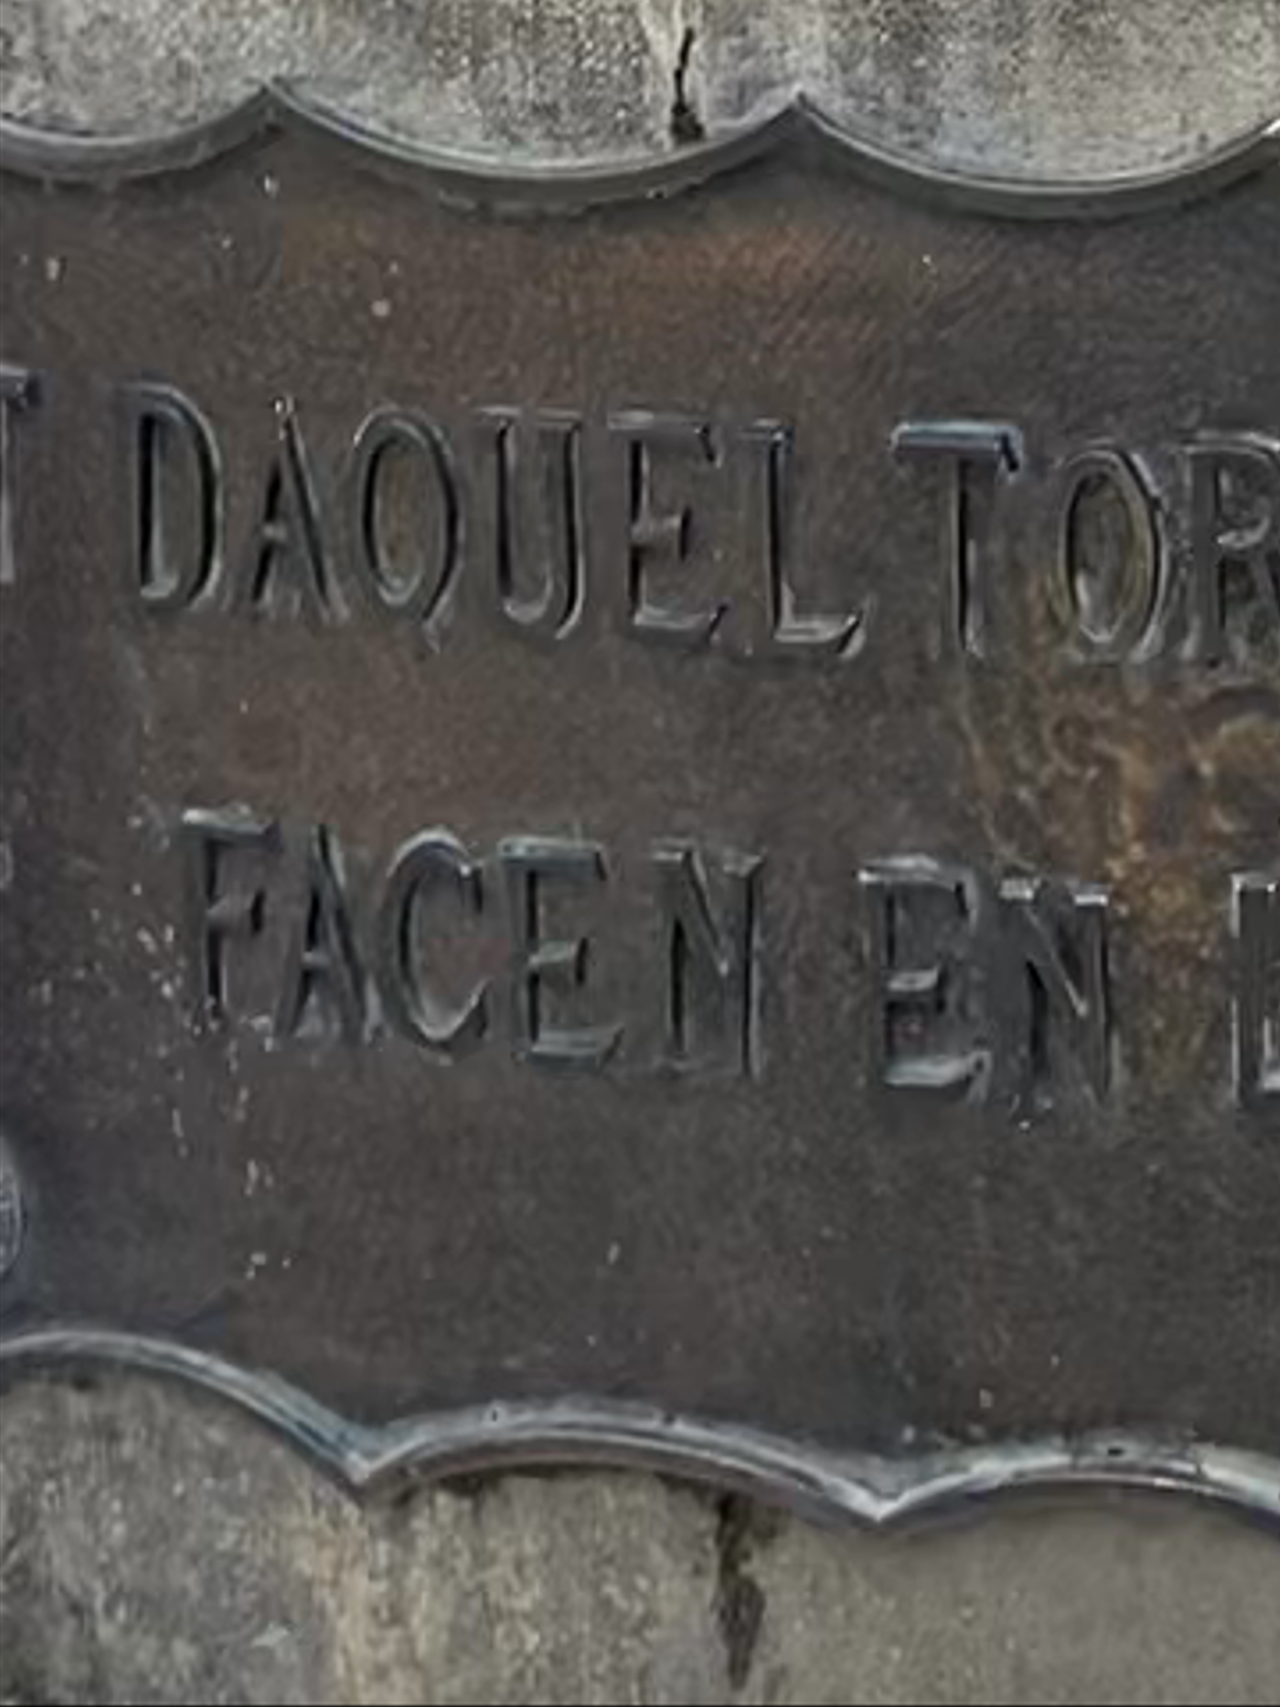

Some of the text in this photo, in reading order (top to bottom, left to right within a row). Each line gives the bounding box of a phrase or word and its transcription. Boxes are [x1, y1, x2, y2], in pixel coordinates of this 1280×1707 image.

[118, 378, 866, 658] DAQUEL
[180, 802, 768, 1078] FACEN
[857, 855, 1118, 1106] EN
